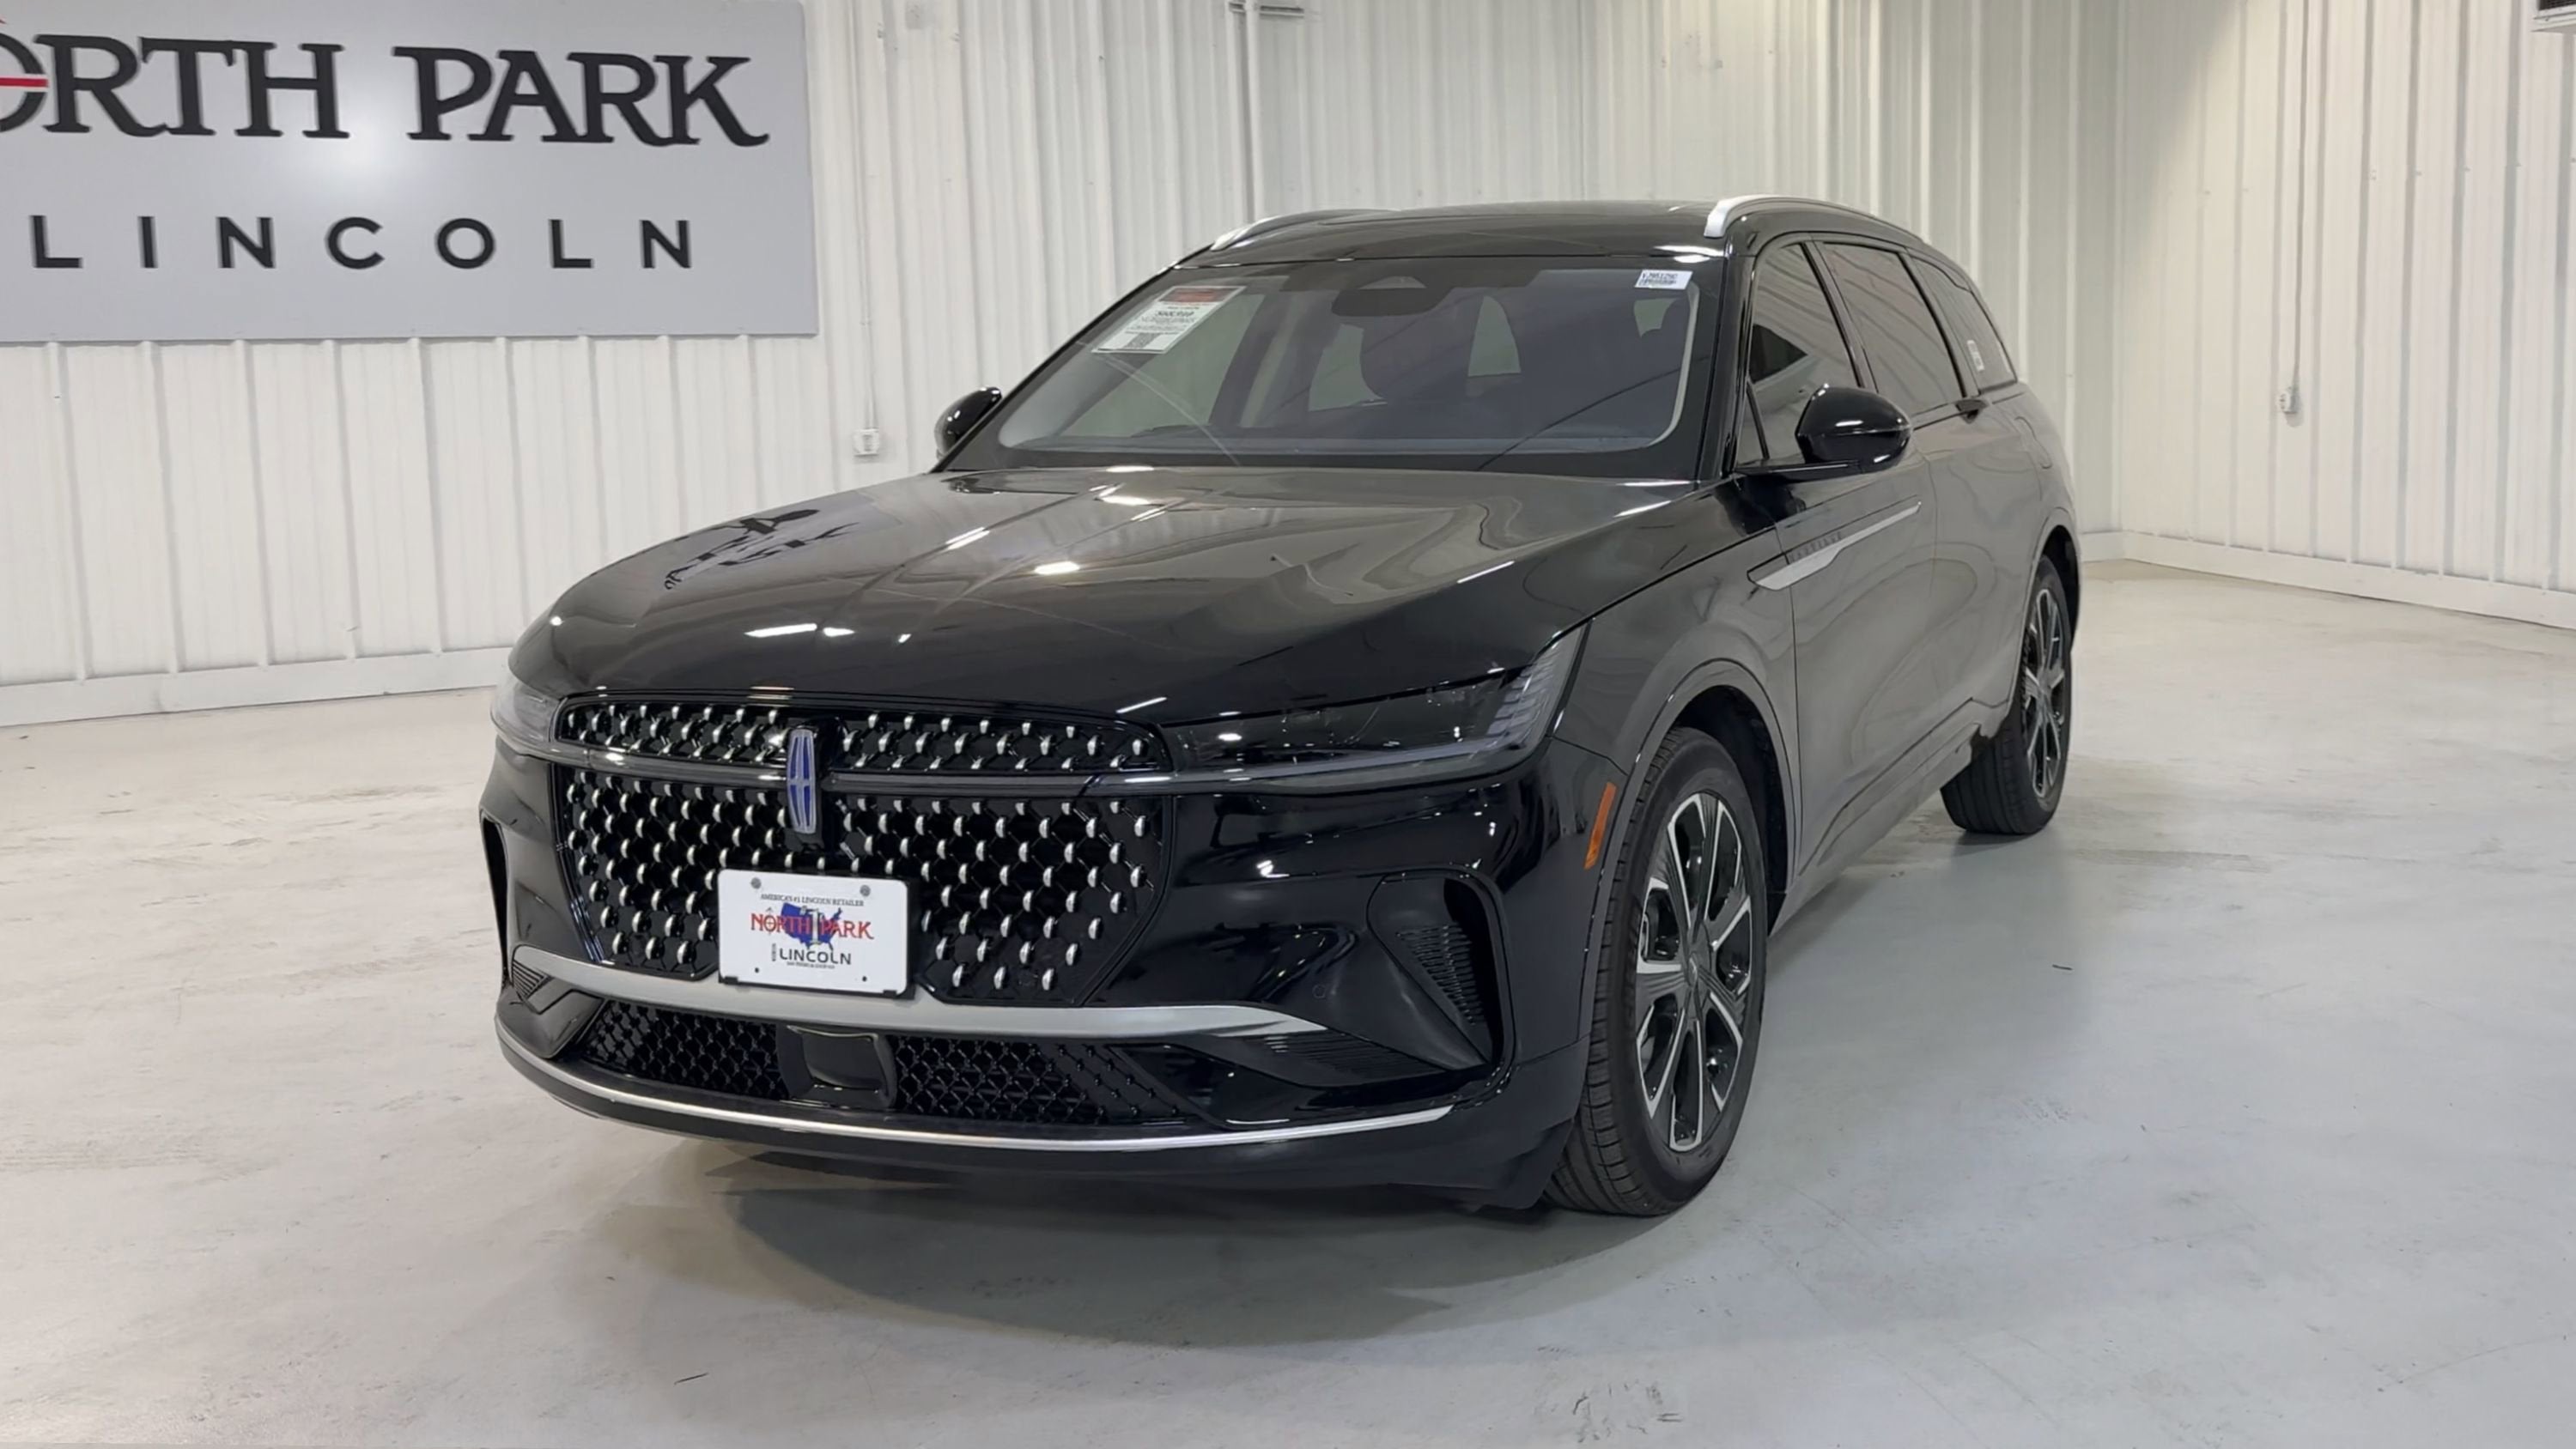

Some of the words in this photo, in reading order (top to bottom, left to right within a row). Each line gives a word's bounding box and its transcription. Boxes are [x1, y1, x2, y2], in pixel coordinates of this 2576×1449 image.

[393, 46, 769, 147] PARK
[32, 215, 690, 269] LINCOLN
[801, 895, 831, 905] LINCOLN
[832, 897, 864, 906] RETAILER
[750, 912, 811, 934] NORTH
[821, 916, 874, 940] PARK
[779, 948, 852, 965] LINCOLN
